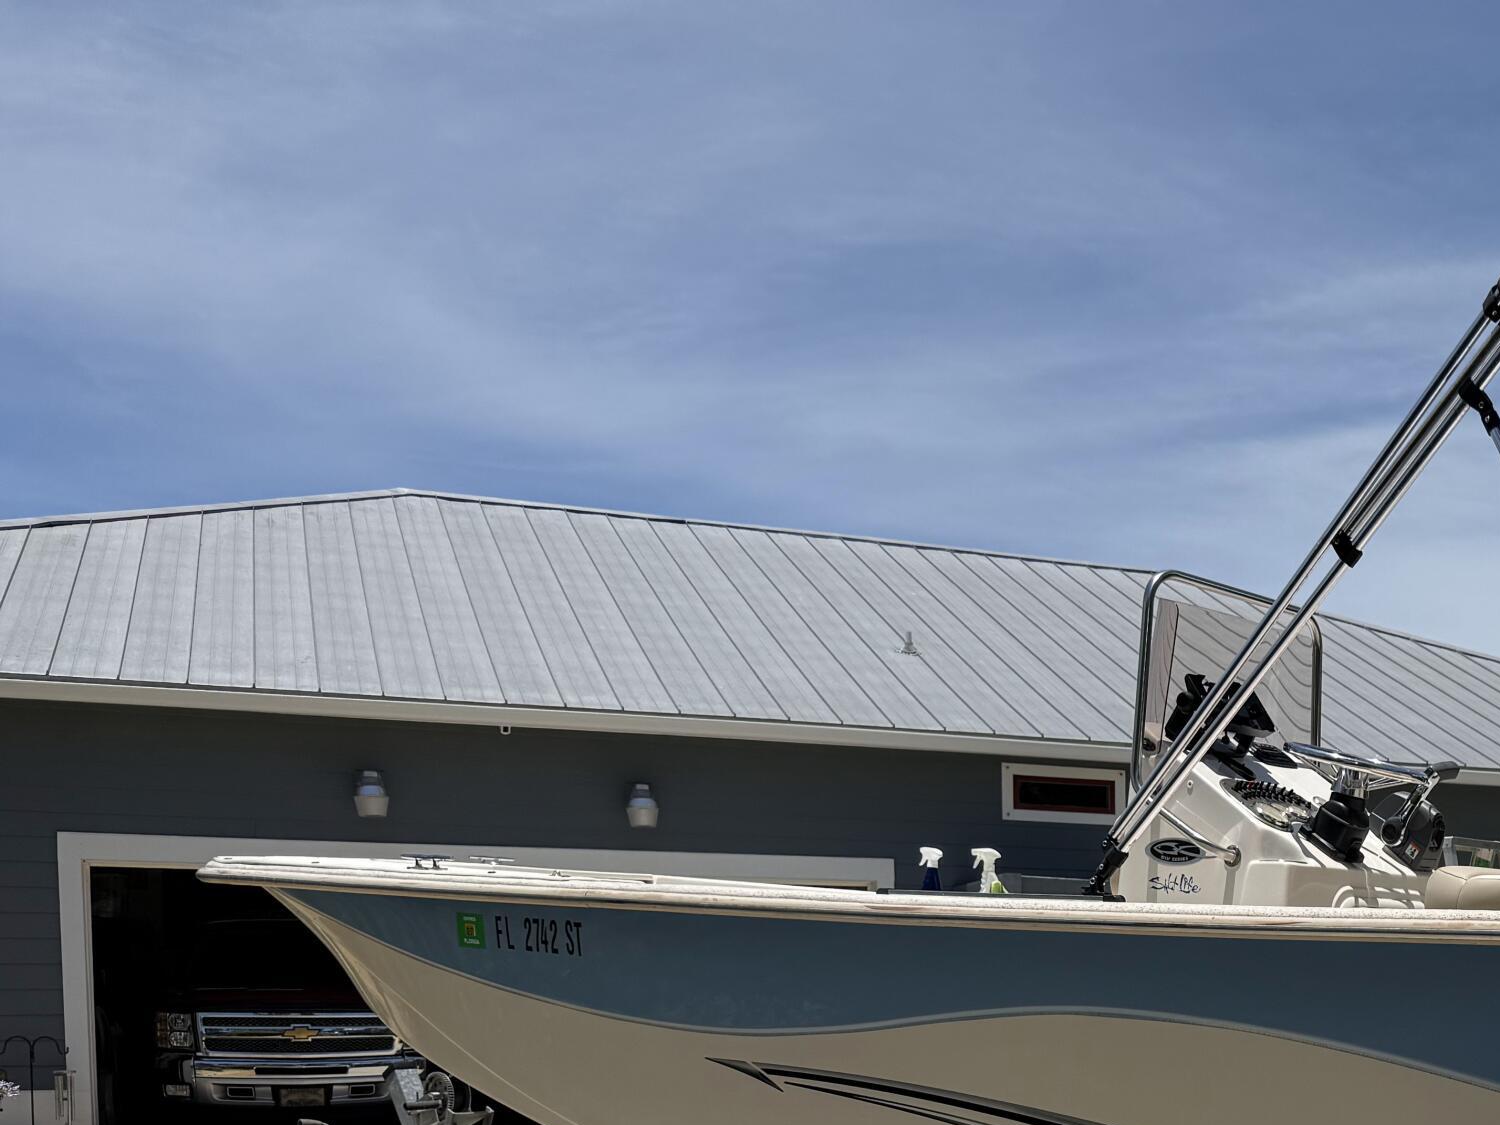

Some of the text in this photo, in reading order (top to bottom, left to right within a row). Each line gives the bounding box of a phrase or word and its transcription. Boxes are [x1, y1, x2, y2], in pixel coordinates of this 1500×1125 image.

[495, 916, 515, 950] FL
[524, 917, 559, 954] 2742
[565, 920, 582, 956] ST
